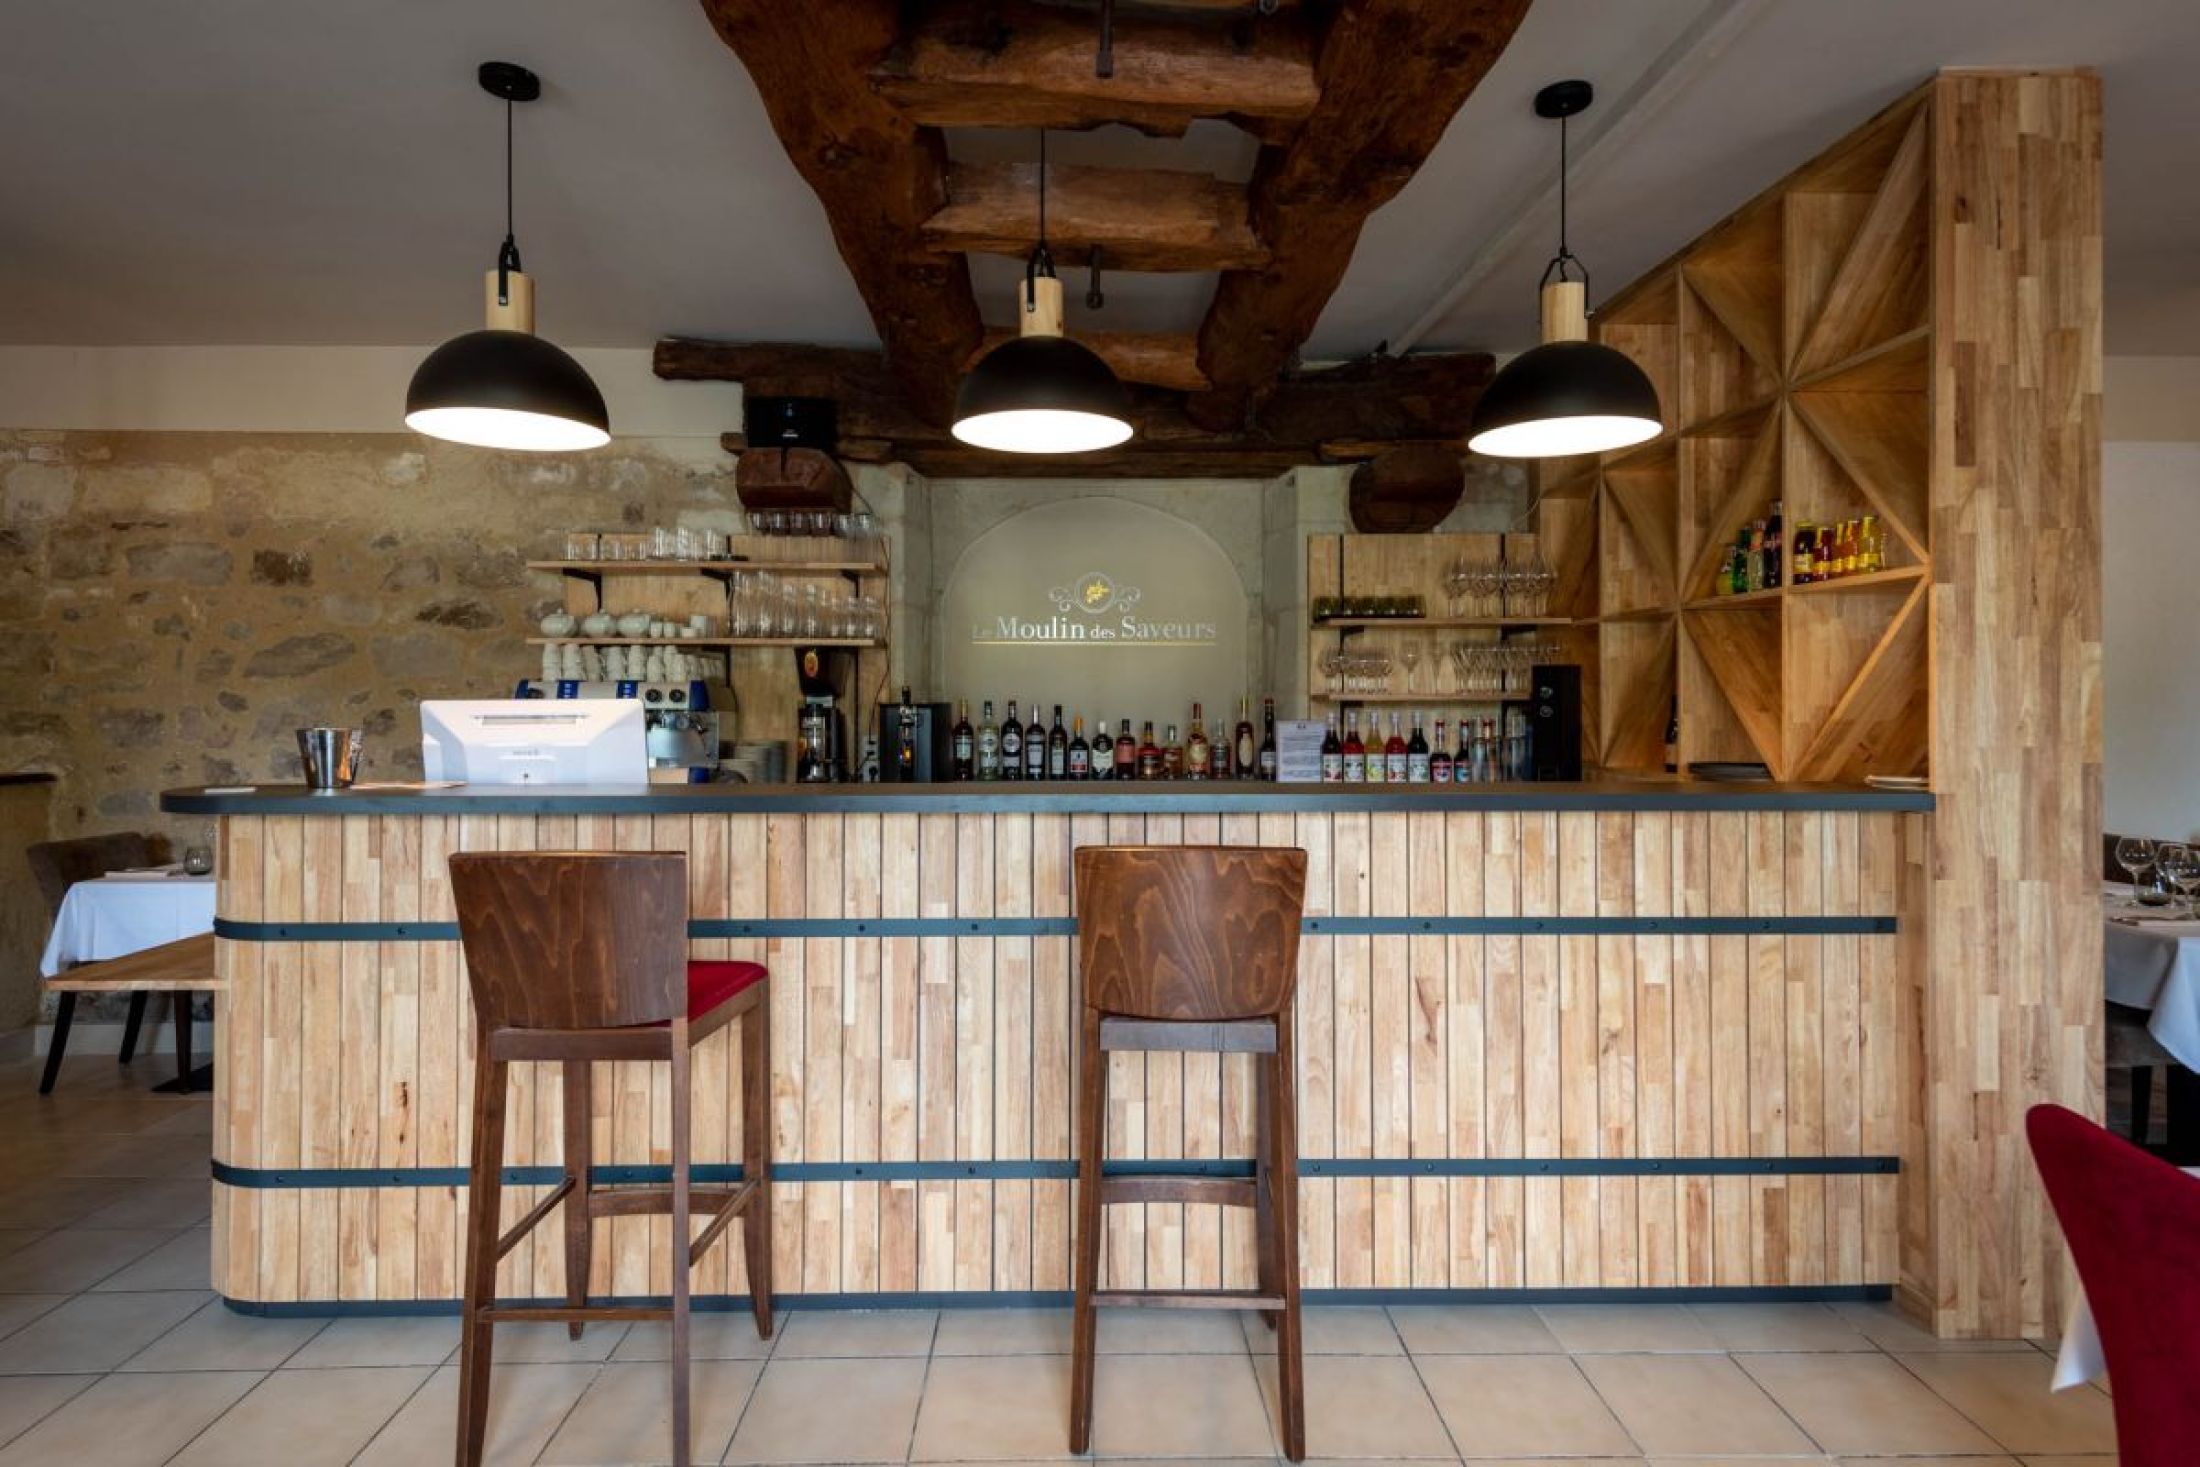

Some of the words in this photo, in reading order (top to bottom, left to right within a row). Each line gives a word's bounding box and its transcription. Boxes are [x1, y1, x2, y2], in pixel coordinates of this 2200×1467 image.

[997, 615, 1085, 639] Moulin
[1090, 623, 1116, 639] des
[1121, 615, 1216, 639] Saveurs
